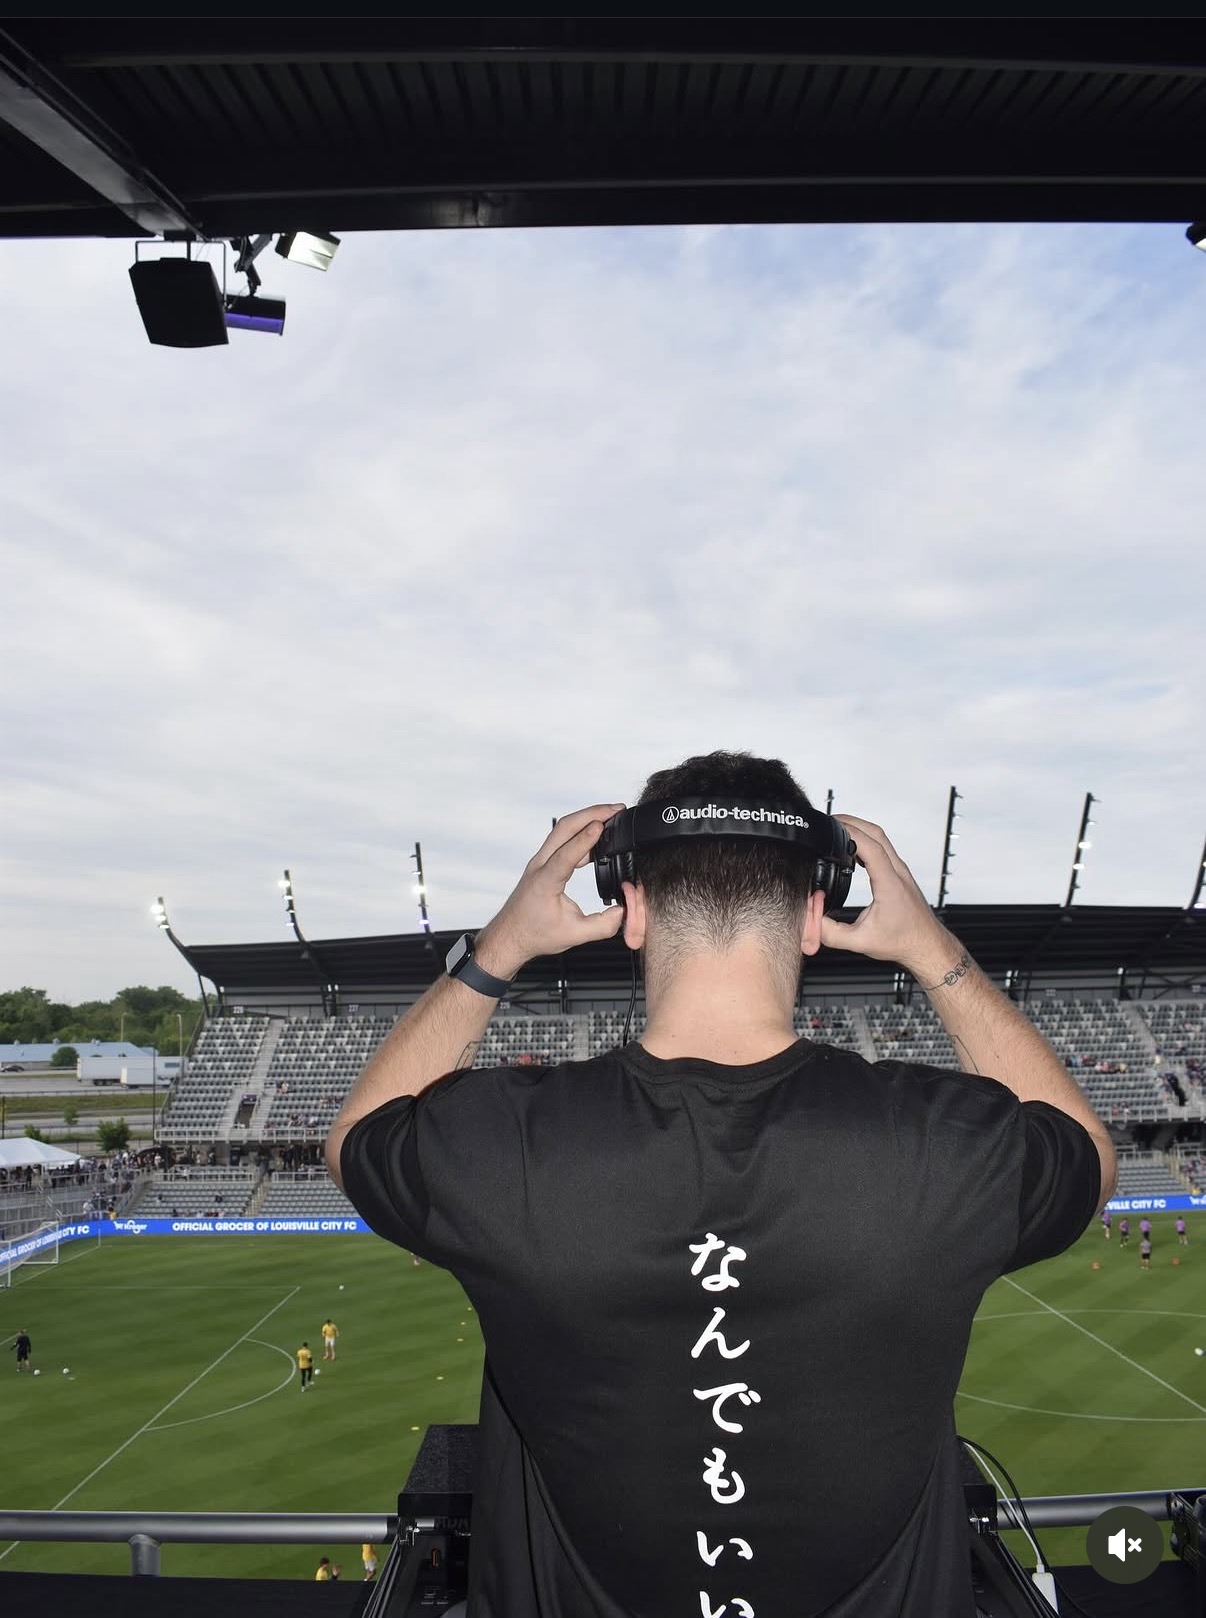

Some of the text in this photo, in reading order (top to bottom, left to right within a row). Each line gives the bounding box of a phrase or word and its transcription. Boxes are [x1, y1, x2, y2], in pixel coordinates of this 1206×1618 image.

[1107, 1199, 1166, 1210] VILLE CITY FC
[77, 1225, 90, 1235] FC
[172, 1221, 357, 1231] OFFICIAL GROCER OF LOUISVILLE CITY FC
[688, 1232, 762, 1618] なんでもいい
